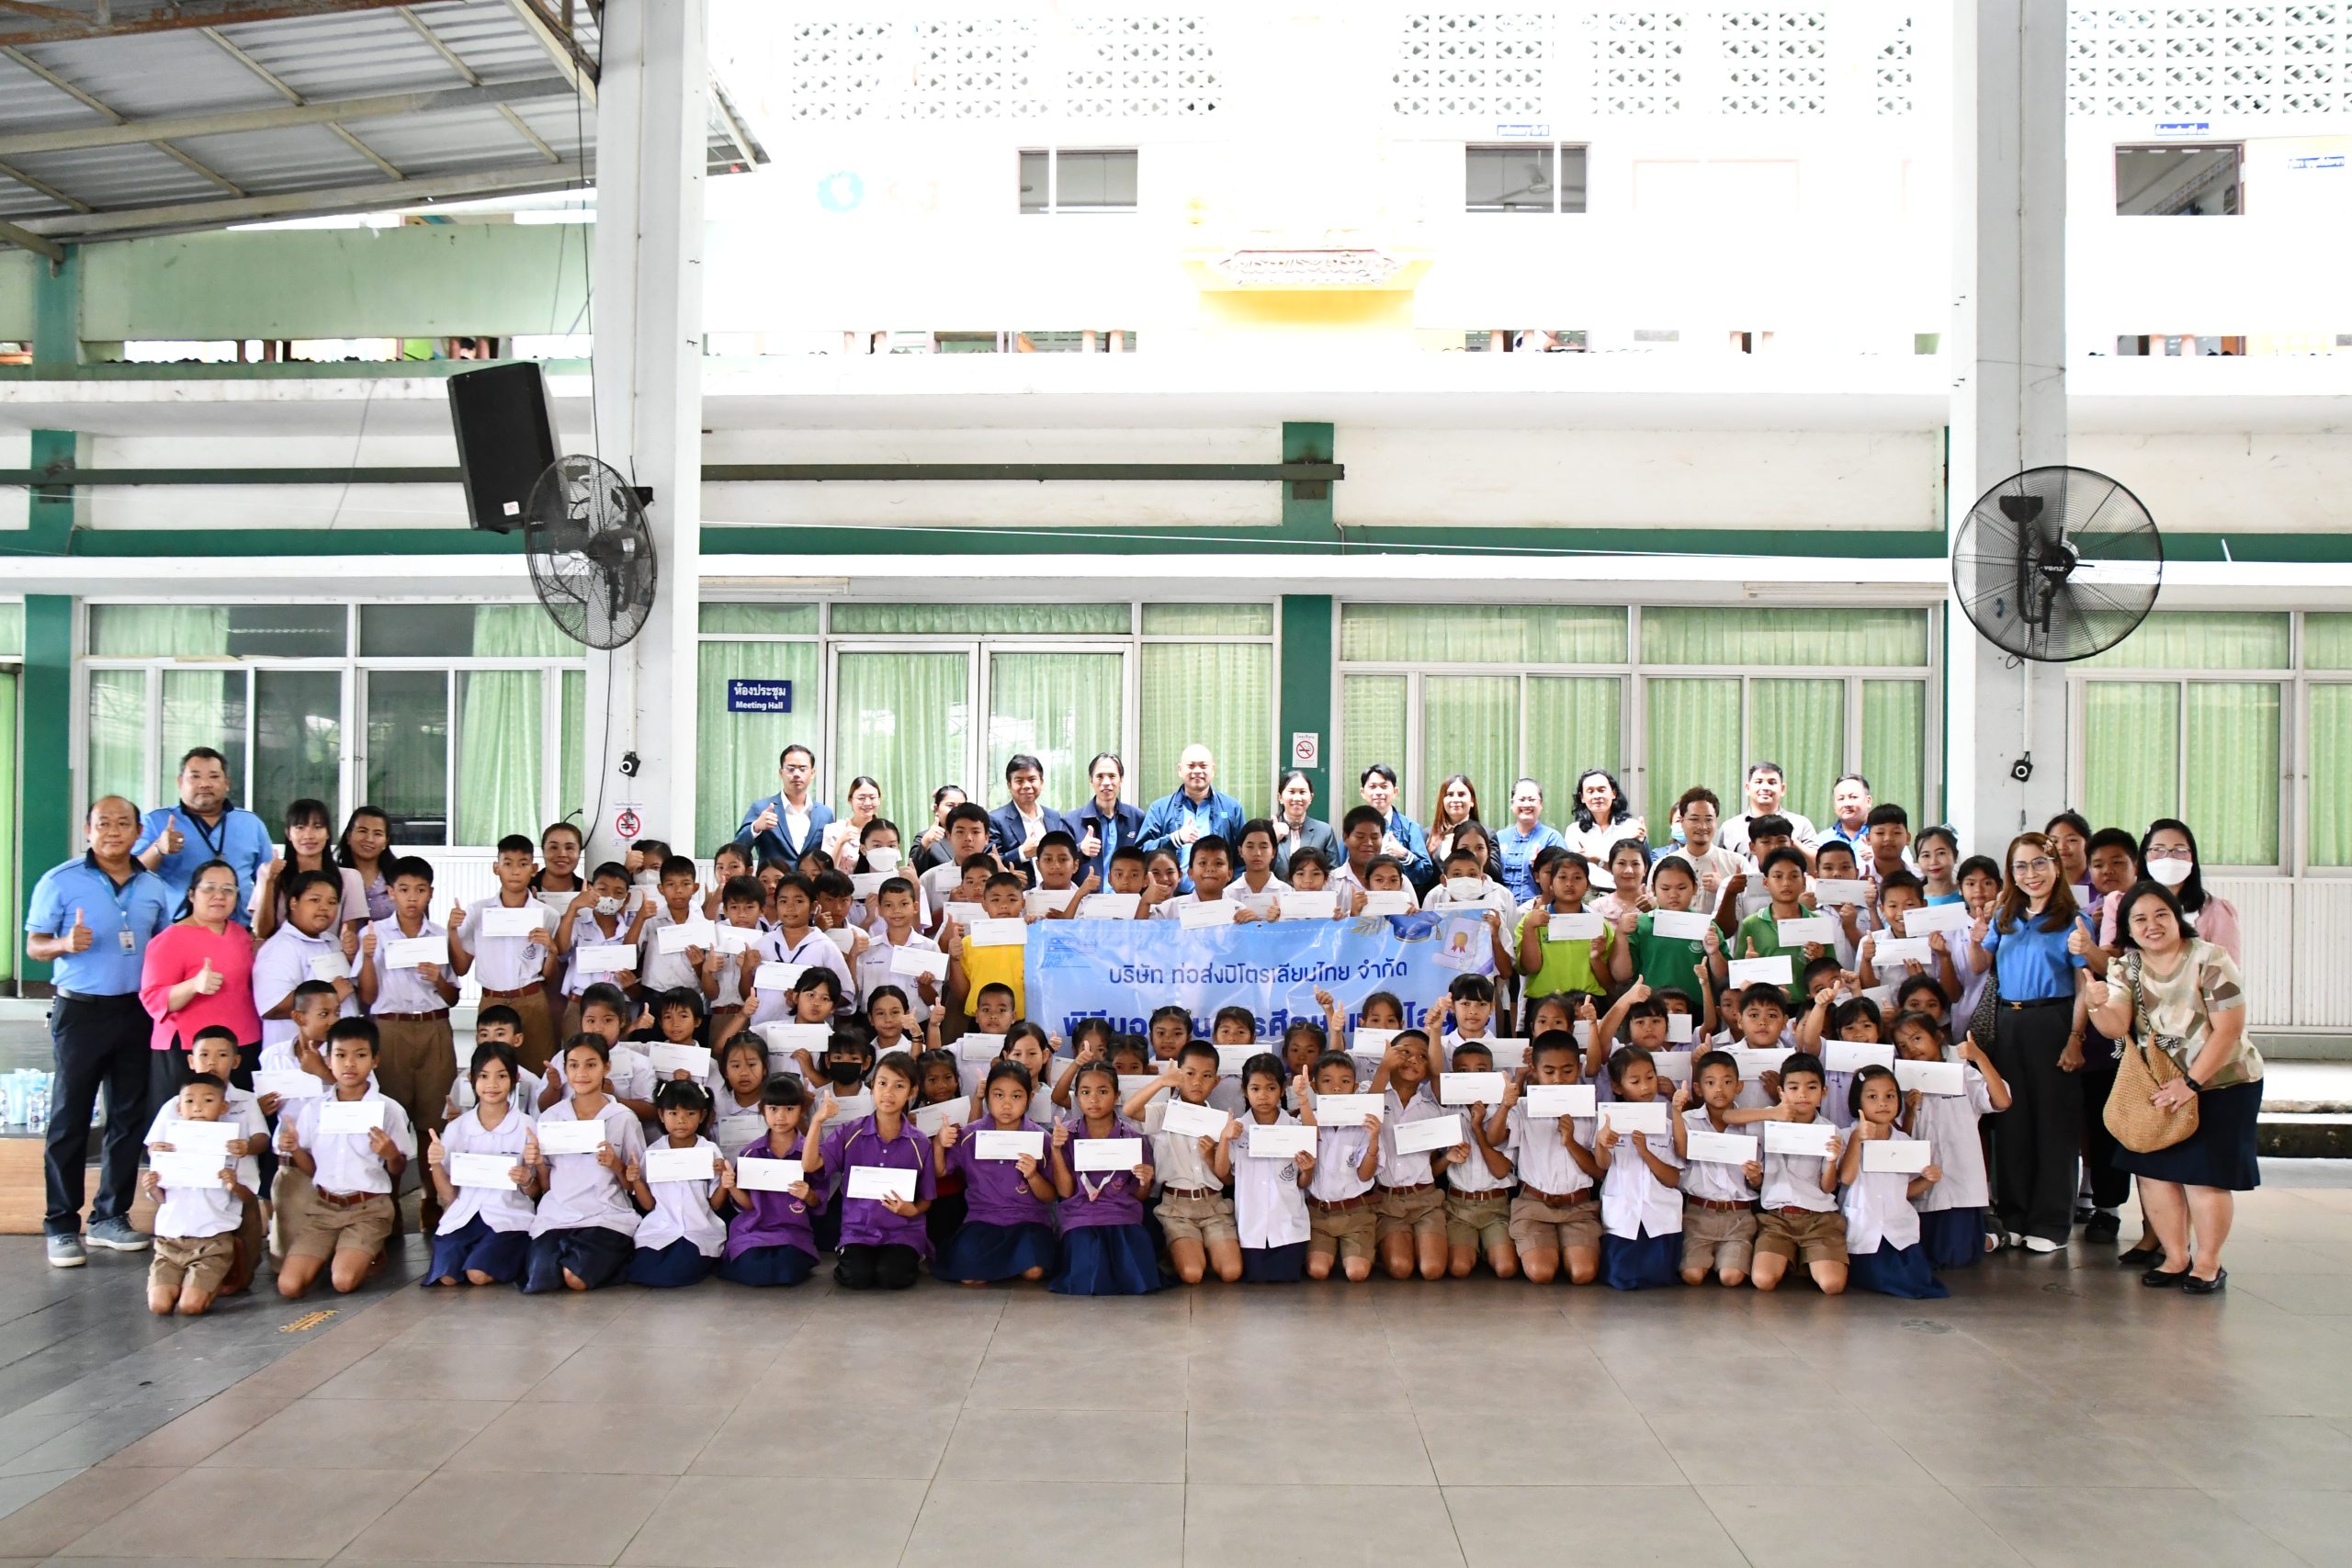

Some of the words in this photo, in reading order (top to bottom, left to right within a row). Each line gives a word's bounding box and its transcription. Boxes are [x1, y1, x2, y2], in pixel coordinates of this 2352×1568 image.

[734, 682, 786, 700] ห้องประชุม
[736, 701, 766, 711] Meeting
[768, 701, 784, 710] Hall
[1109, 964, 1164, 984] บริษัท
[1171, 962, 1350, 984] ท่อส่งปิโตรเลียมไทย
[1357, 957, 1408, 980] จำกัด
